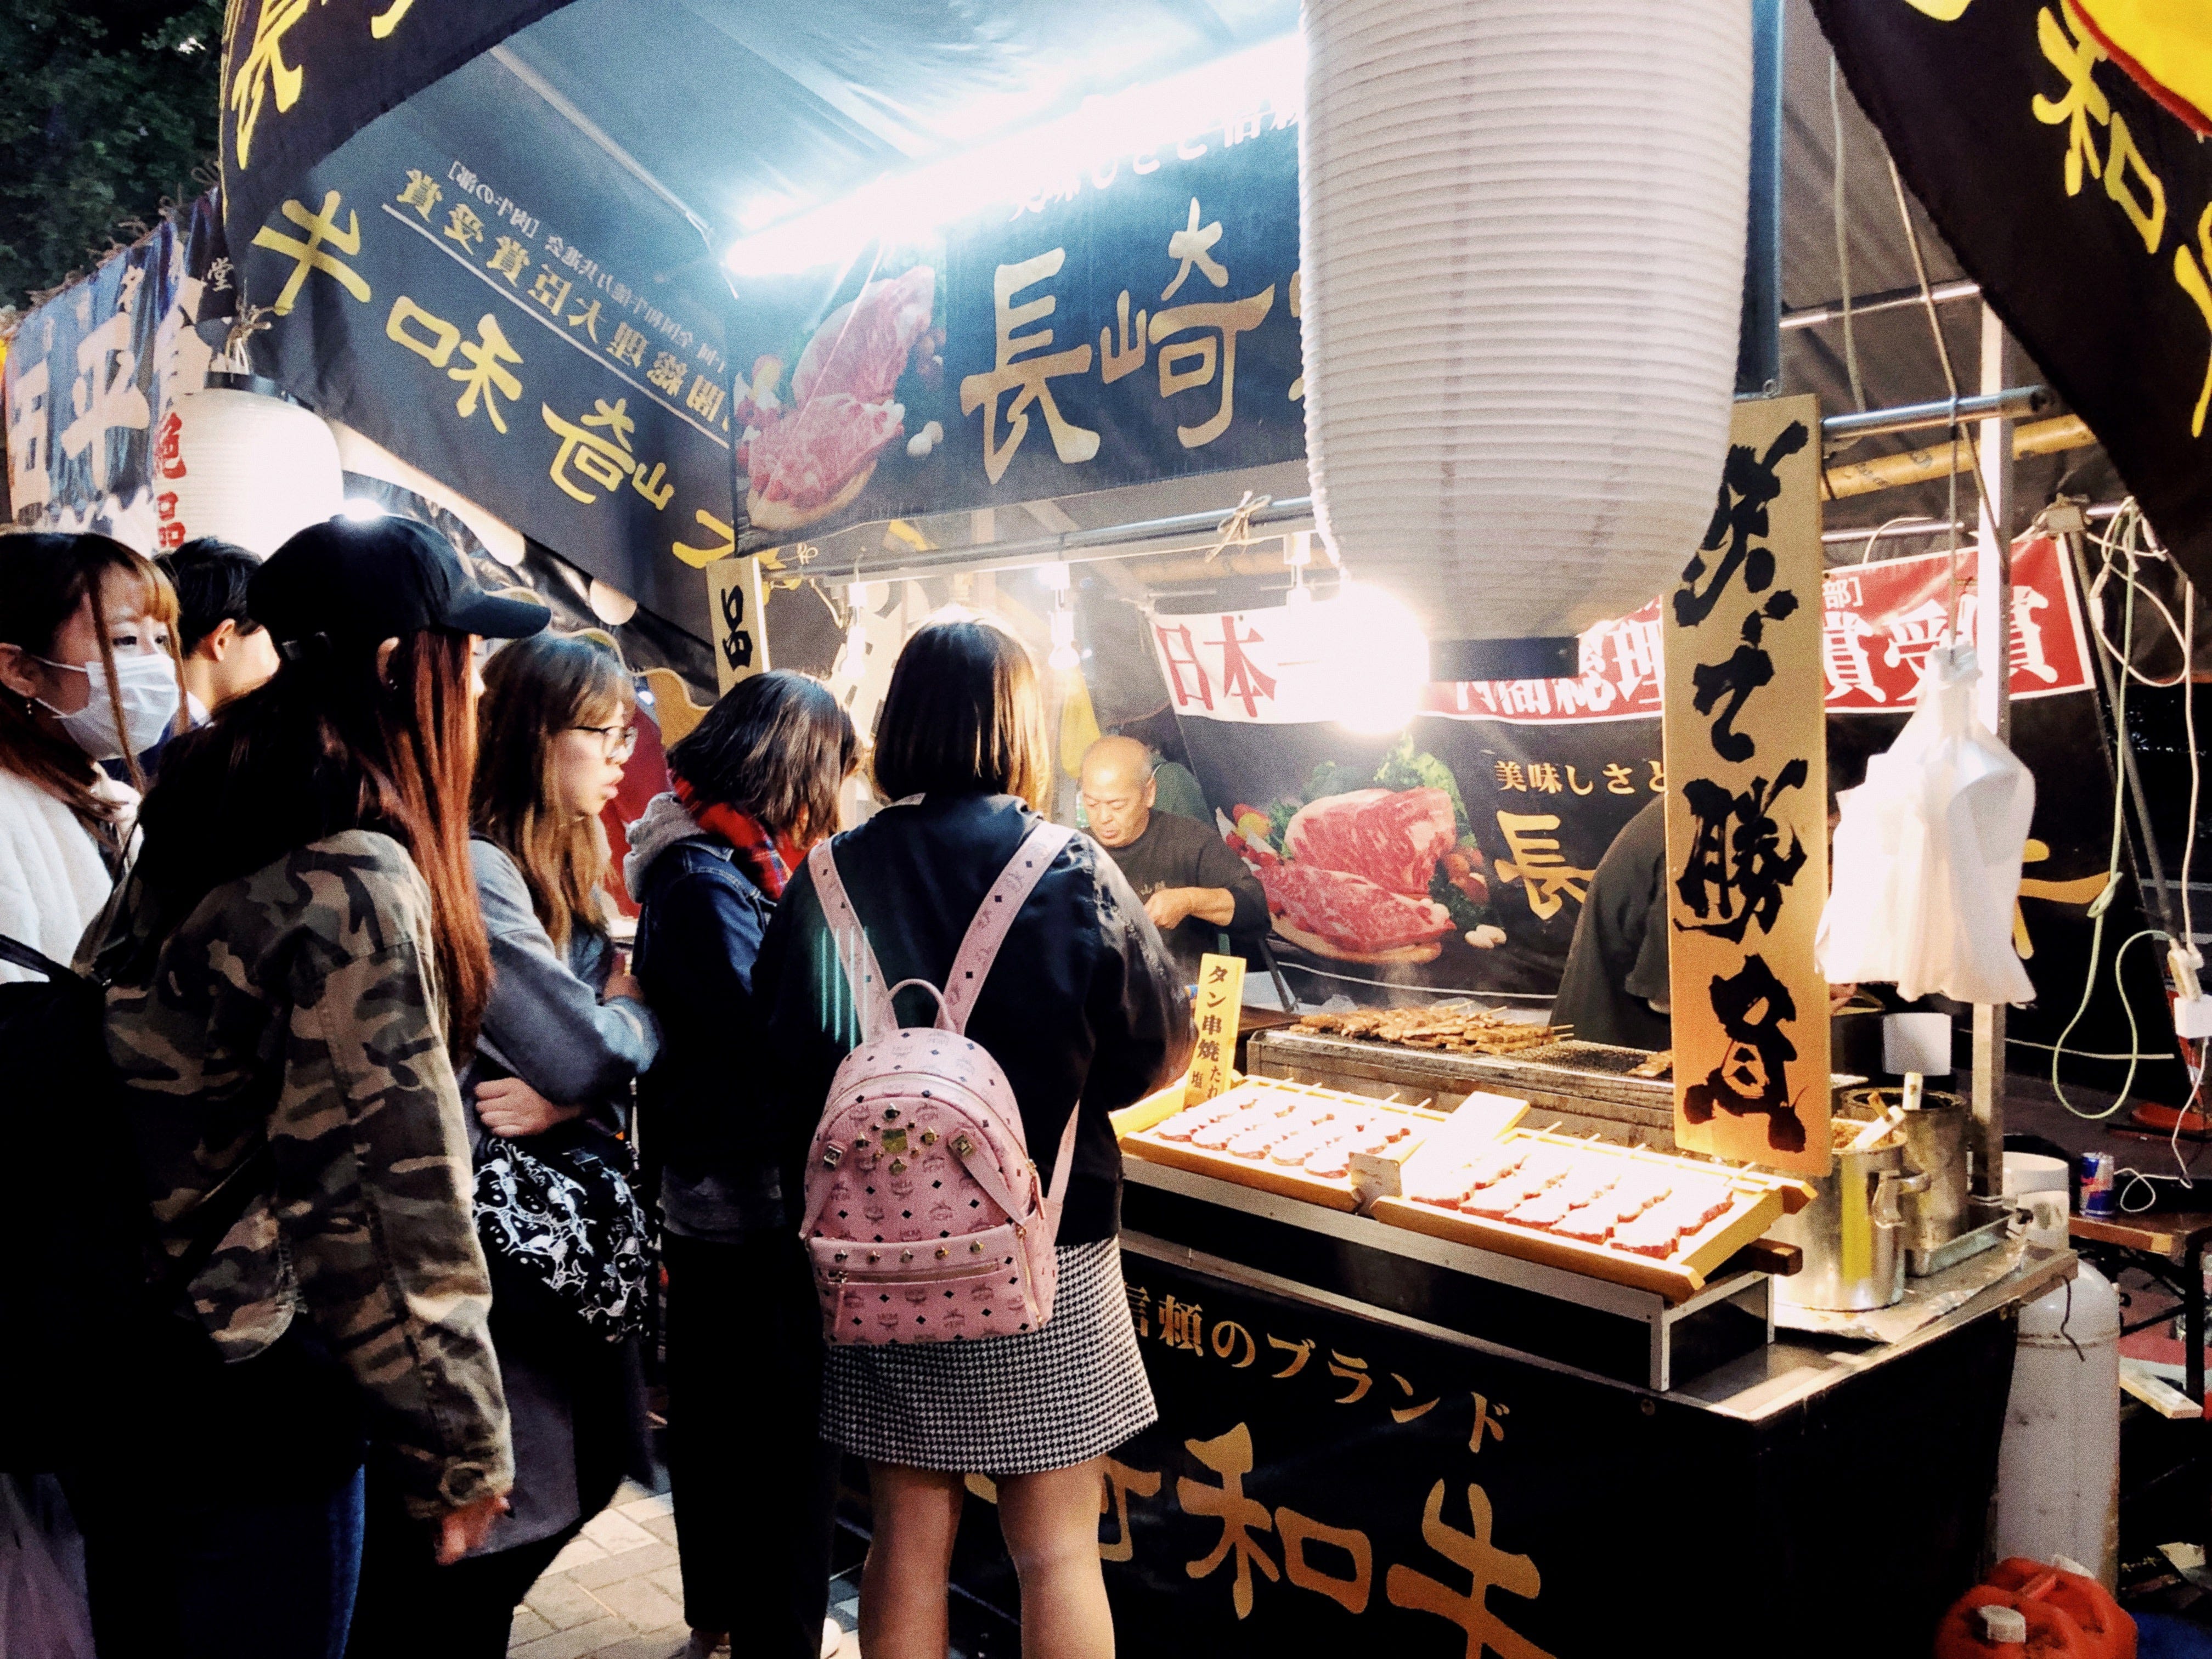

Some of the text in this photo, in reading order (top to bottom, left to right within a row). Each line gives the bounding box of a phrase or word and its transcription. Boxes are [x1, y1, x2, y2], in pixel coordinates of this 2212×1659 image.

[960, 196, 1304, 484] 長崎
[1494, 760, 1666, 795] 美味しさと
